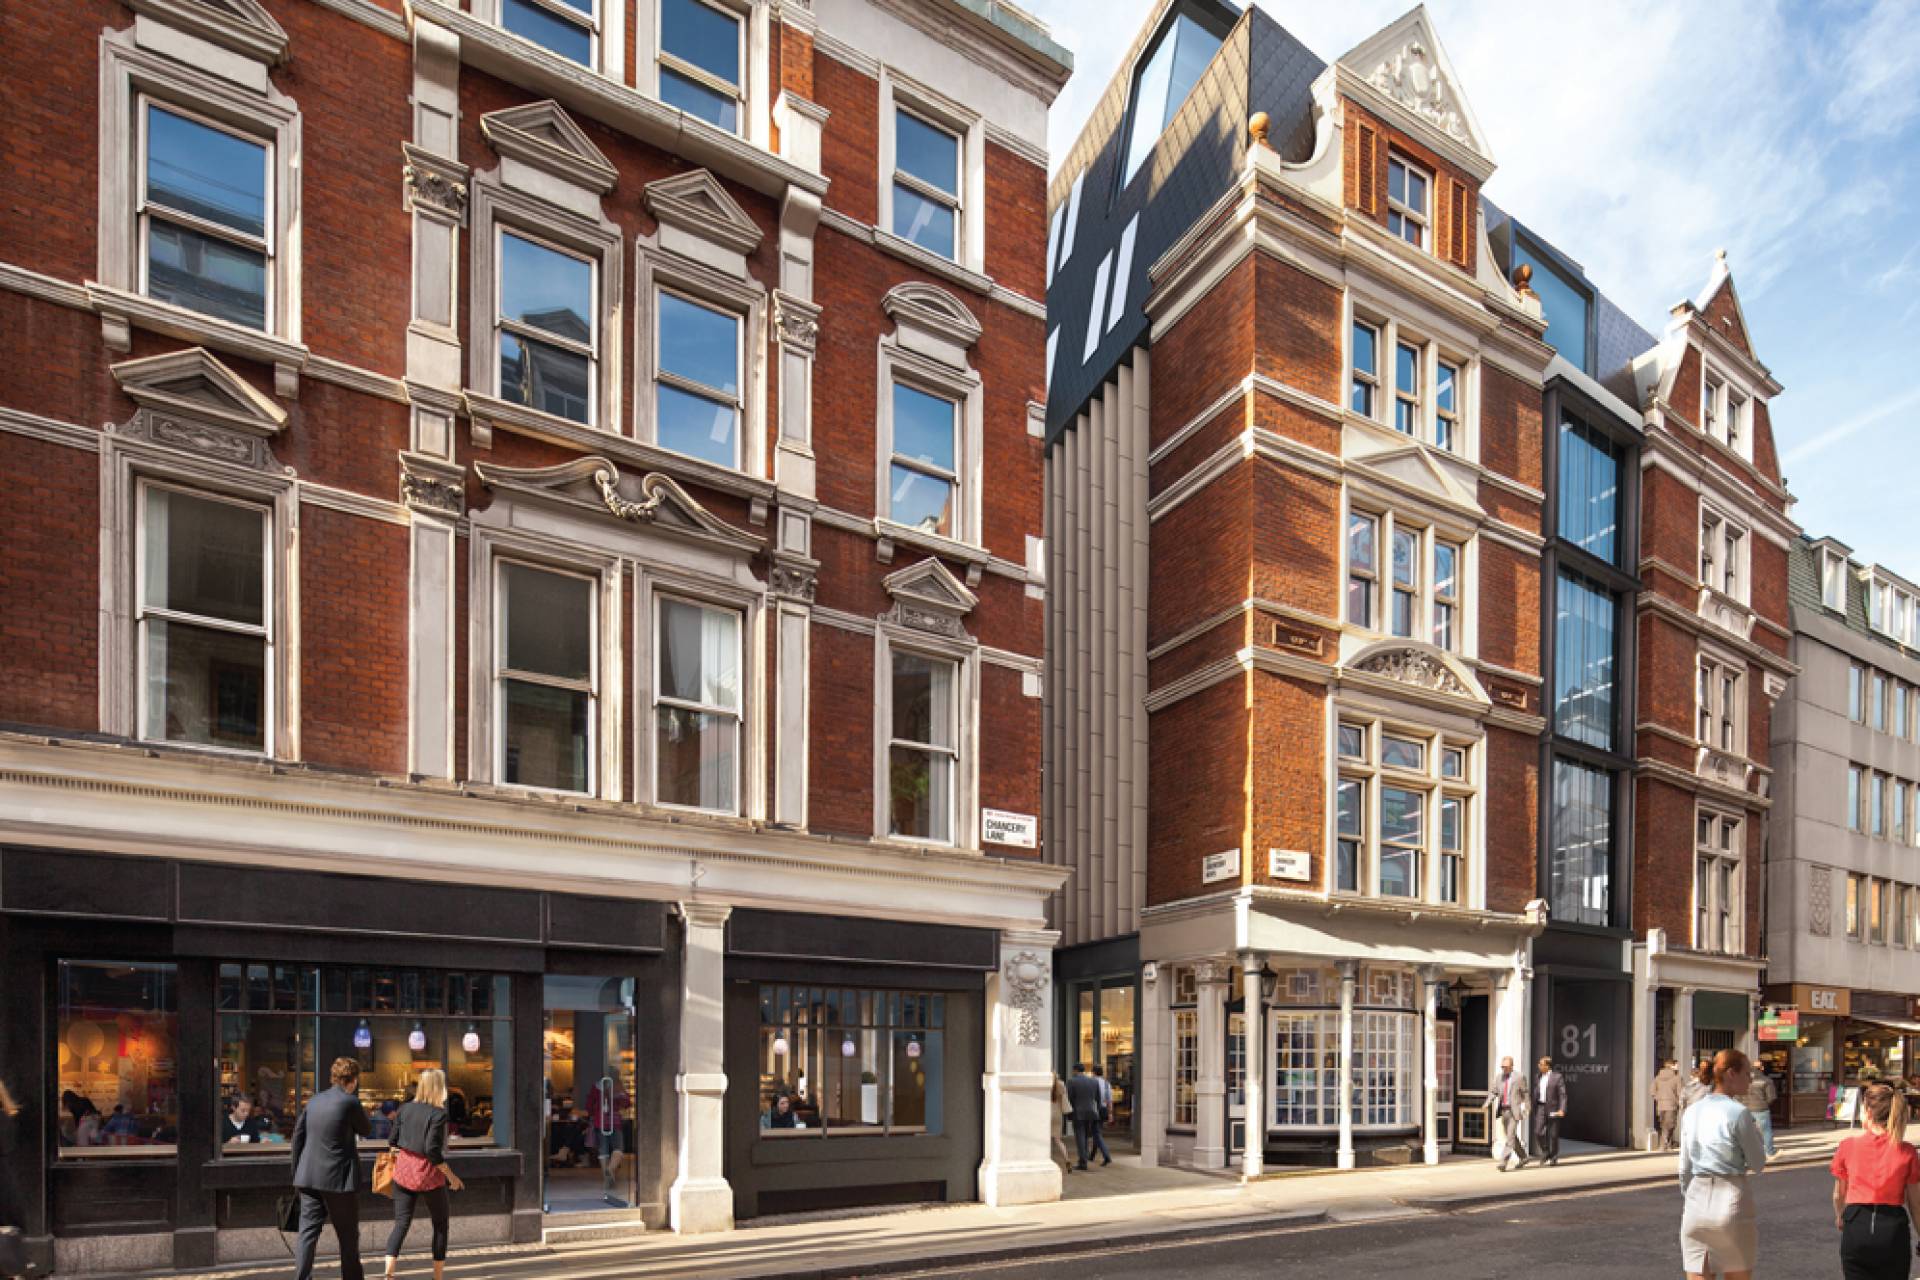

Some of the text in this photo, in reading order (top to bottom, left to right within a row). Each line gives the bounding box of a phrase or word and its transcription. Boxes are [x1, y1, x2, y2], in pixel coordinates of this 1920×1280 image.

[986, 819, 1026, 833] CHANCERY
[986, 830, 1005, 841] LANE
[1561, 1023, 1597, 1059] 81
[1553, 1063, 1609, 1074] CHANCERY
